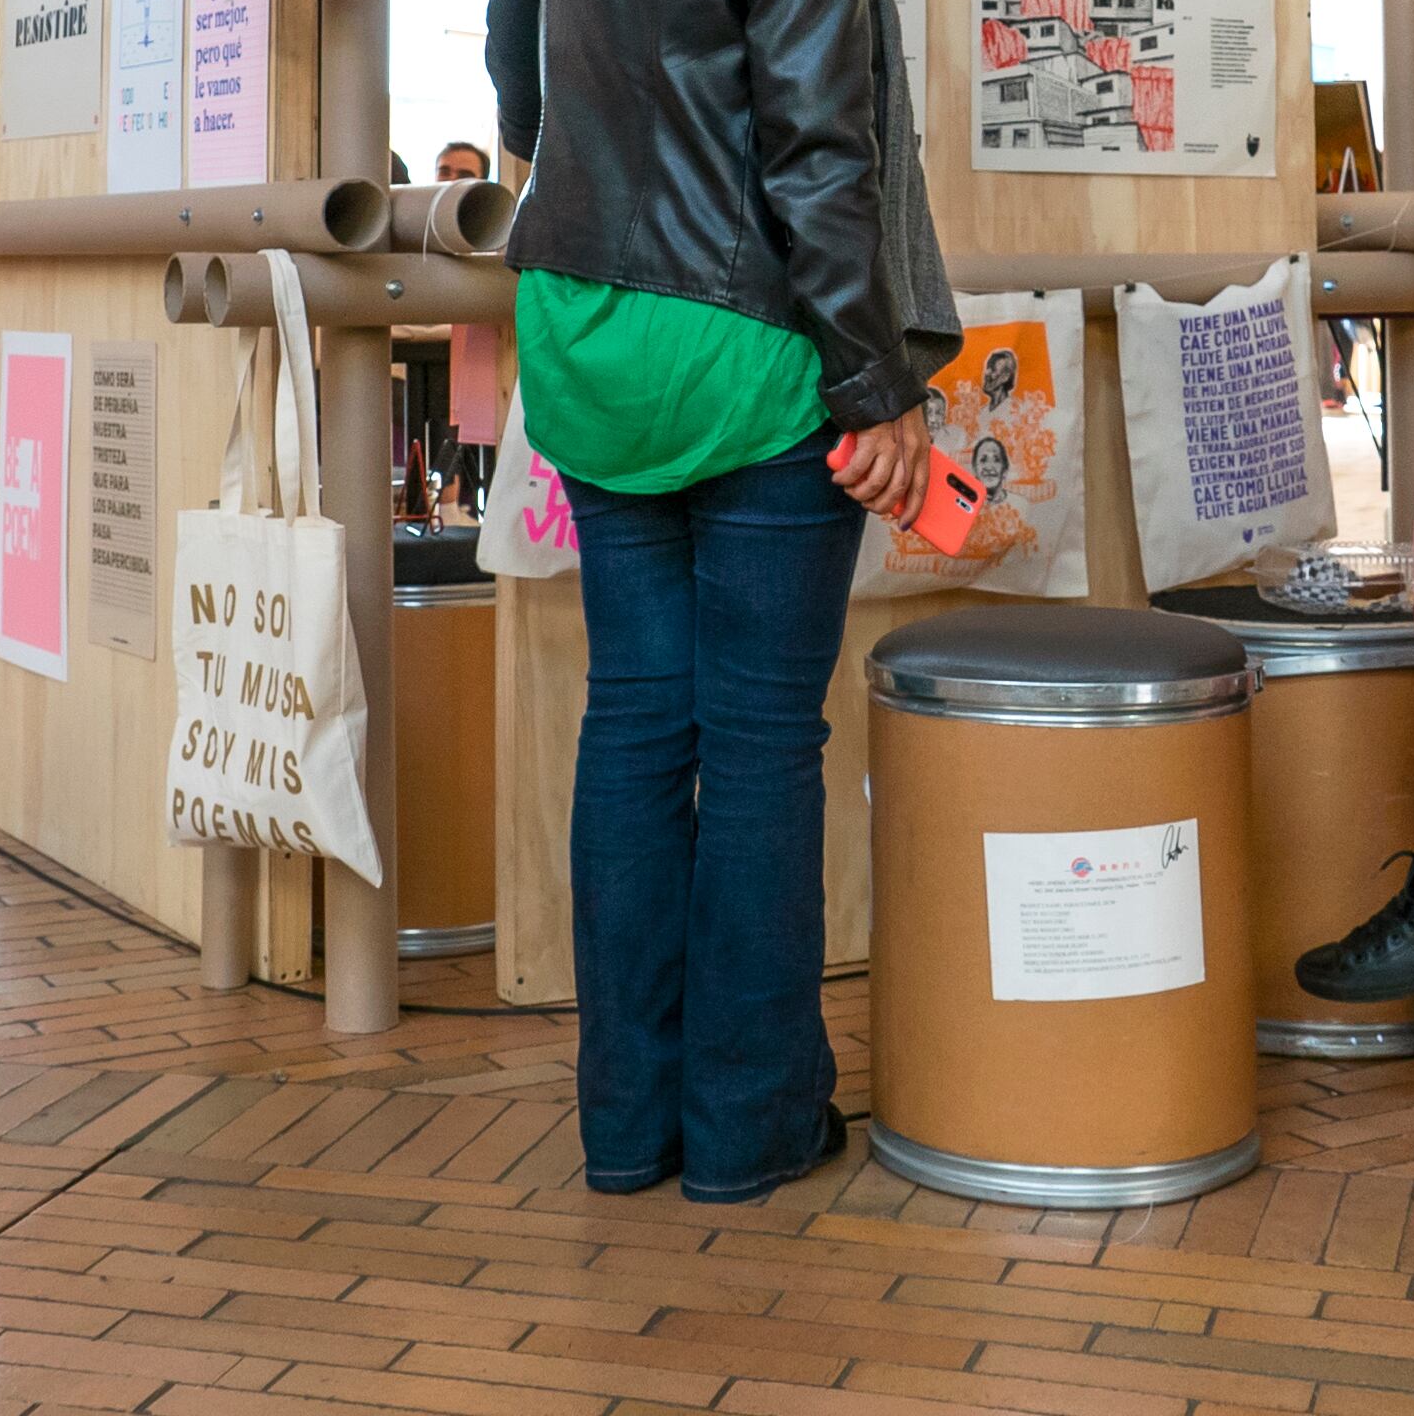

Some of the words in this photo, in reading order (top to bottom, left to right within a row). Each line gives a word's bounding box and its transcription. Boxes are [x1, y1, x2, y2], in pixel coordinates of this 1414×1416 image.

[196, 13, 213, 32] ser
[214, 3, 248, 34] mejor,
[195, 47, 220, 72] pero
[222, 36, 242, 67] qué
[195, 76, 205, 99] le
[206, 75, 241, 98] vamos
[194, 117, 201, 133] a
[203, 110, 235, 133] hacer.
[1179, 314, 1220, 333] VIENE
[1223, 309, 1247, 326] UNA
[1180, 333, 1210, 351] CAE
[1214, 325, 1250, 347] COMO
[1181, 349, 1223, 367] FLUYE
[1227, 343, 1254, 361] AGUA
[1182, 366, 1224, 384] VIENE
[1229, 361, 1252, 379] UNA
[1183, 386, 1198, 399] DE
[1201, 380, 1249, 397] MUJERES
[1184, 399, 1224, 414] VISTEN
[1228, 396, 1242, 410] DE
[1186, 425, 1229, 443] VIENE
[1233, 420, 1257, 439] UNA
[1189, 454, 1235, 473] EXIGEN
[1239, 448, 1267, 466] PAGO
[1194, 485, 1221, 504] CAE
[1225, 478, 1264, 499] COMO
[1196, 503, 1235, 521] FLUYE
[1238, 496, 1267, 514] AGUA
[190, 584, 236, 628] NO
[254, 589, 291, 641] SO
[196, 651, 226, 697] TU
[240, 664, 315, 721] MUSA
[182, 719, 236, 775] SOY
[245, 739, 302, 795] MIS
[172, 788, 324, 856] POEMAS
